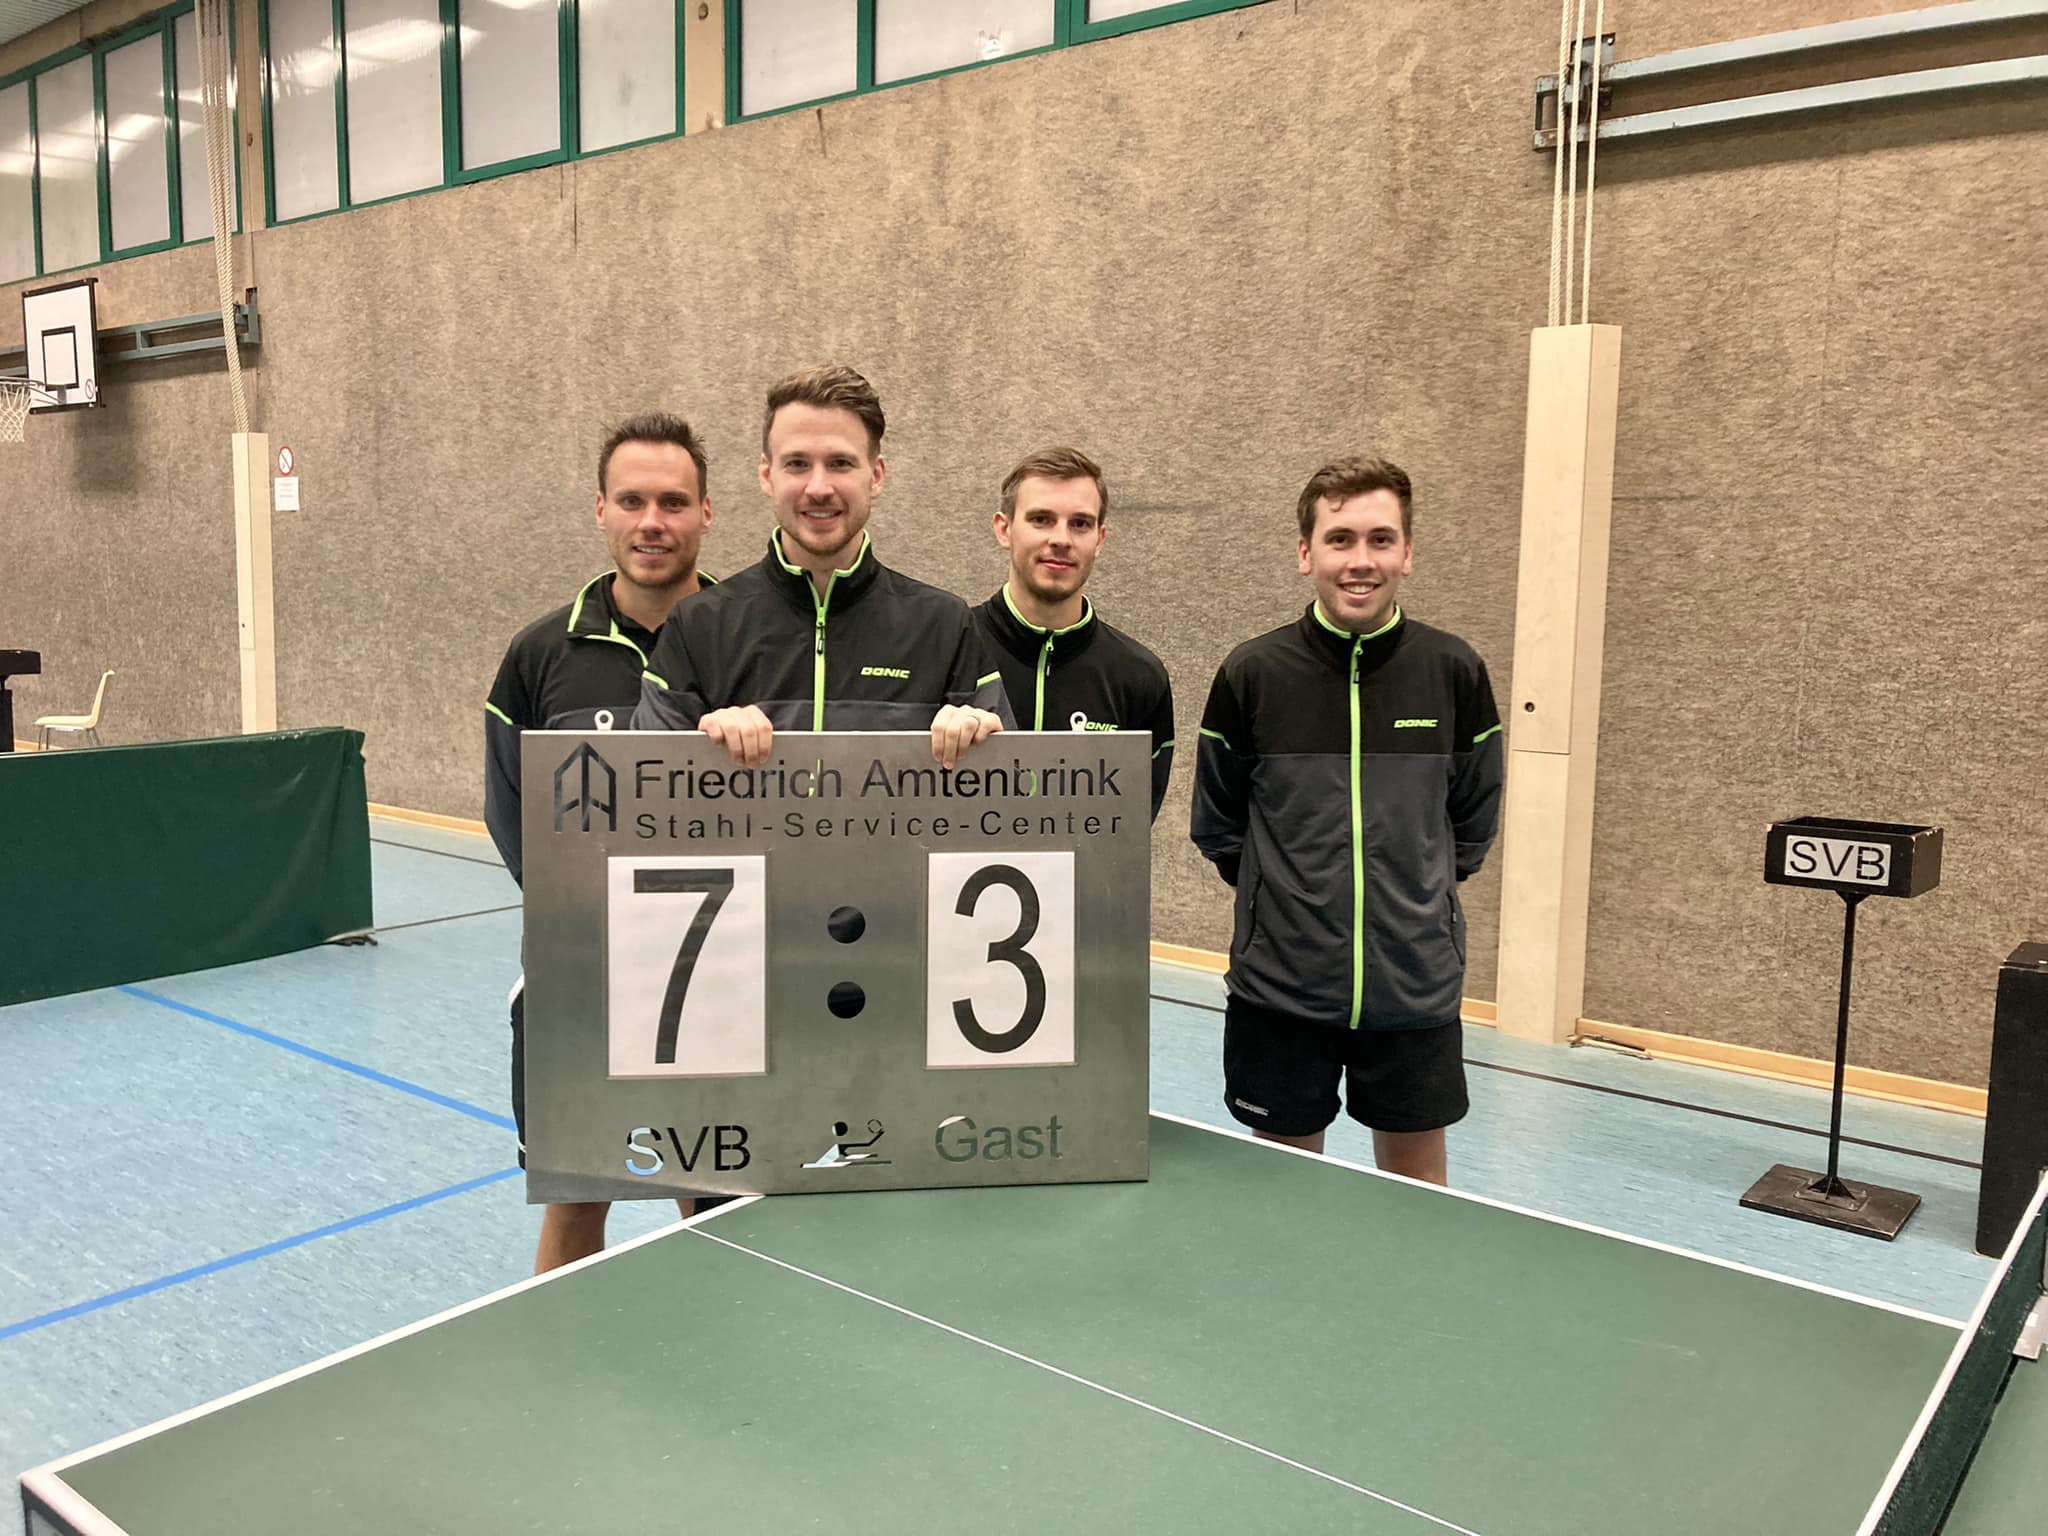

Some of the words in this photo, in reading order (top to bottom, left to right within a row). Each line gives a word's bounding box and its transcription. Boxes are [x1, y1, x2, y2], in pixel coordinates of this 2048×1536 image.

[860, 667, 911, 679] DONIC
[1394, 719, 1439, 728] DONIC
[635, 759, 842, 800] Friedrich
[860, 758, 1122, 799] Amtenbrink
[635, 810, 1123, 840] Stahl-Service-Center
[1789, 840, 1886, 881] SVB
[633, 868, 735, 1064] 7
[952, 864, 1047, 1053] 3
[624, 1125, 752, 1177] SVB
[934, 1114, 1064, 1163] Gast
